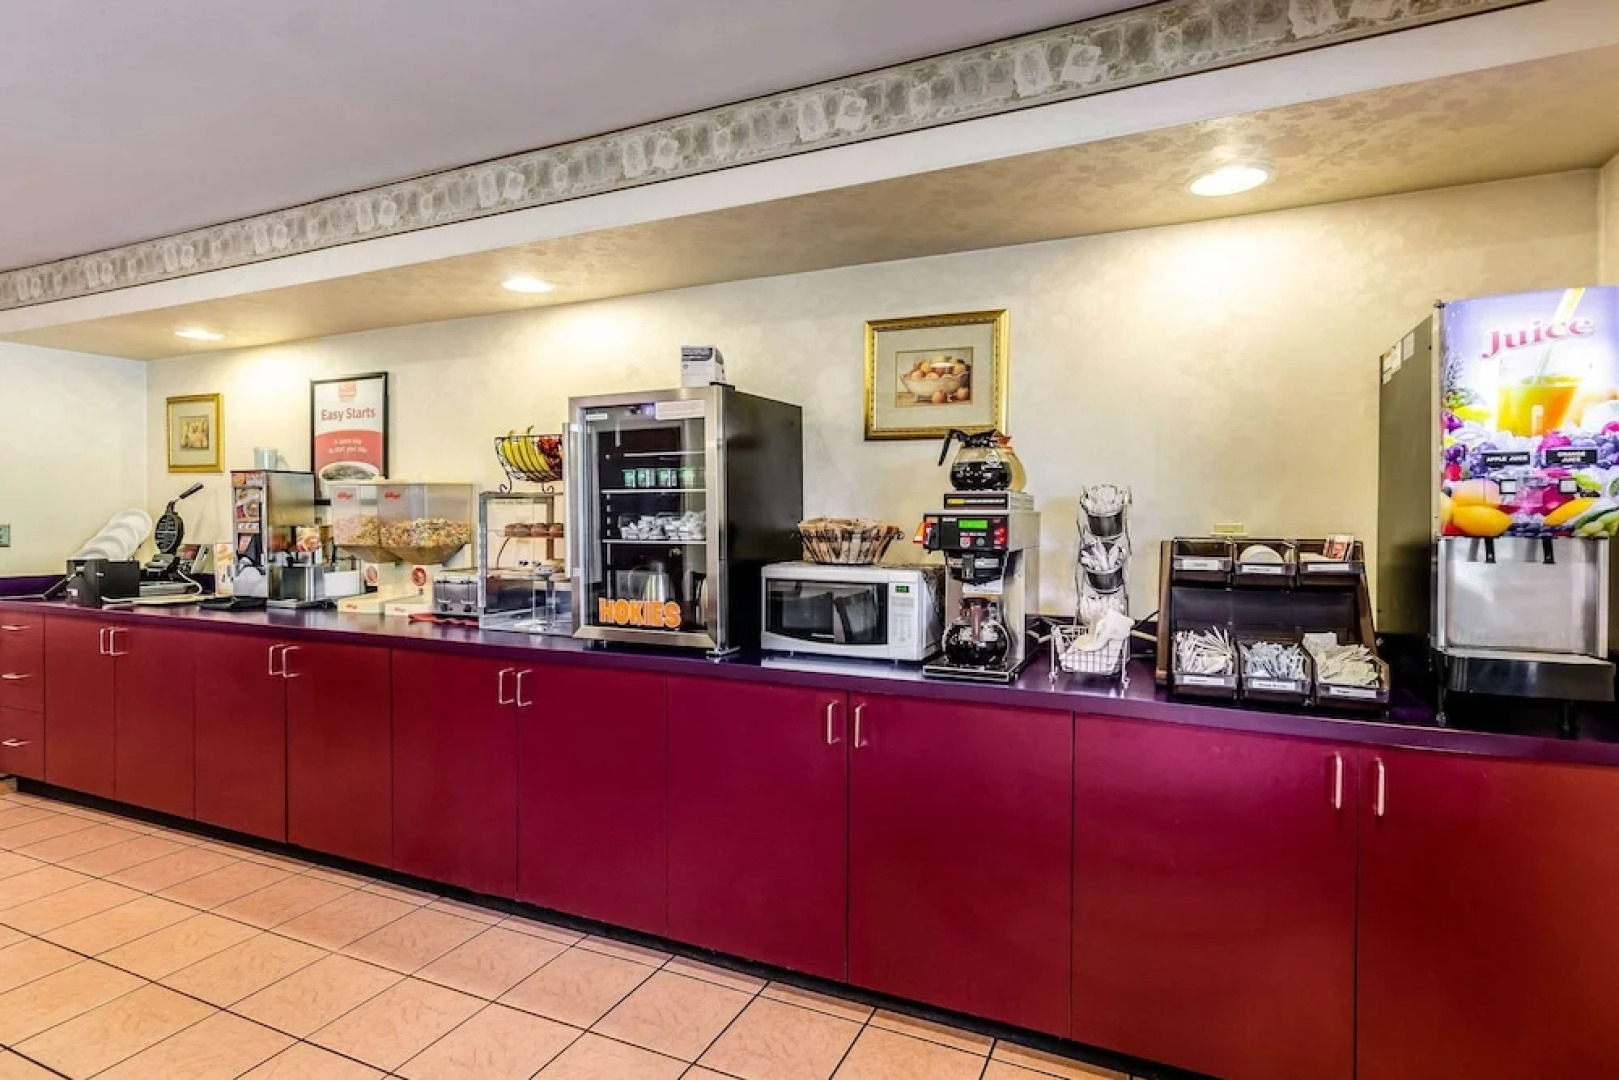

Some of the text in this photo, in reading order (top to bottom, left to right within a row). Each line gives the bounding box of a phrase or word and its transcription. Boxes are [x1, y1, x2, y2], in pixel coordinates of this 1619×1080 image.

[1481, 318, 1595, 359] Juice
[321, 407, 376, 421] Easy Starts
[1486, 454, 1528, 463] APPLE JUICE
[598, 597, 682, 629] HOKIES
